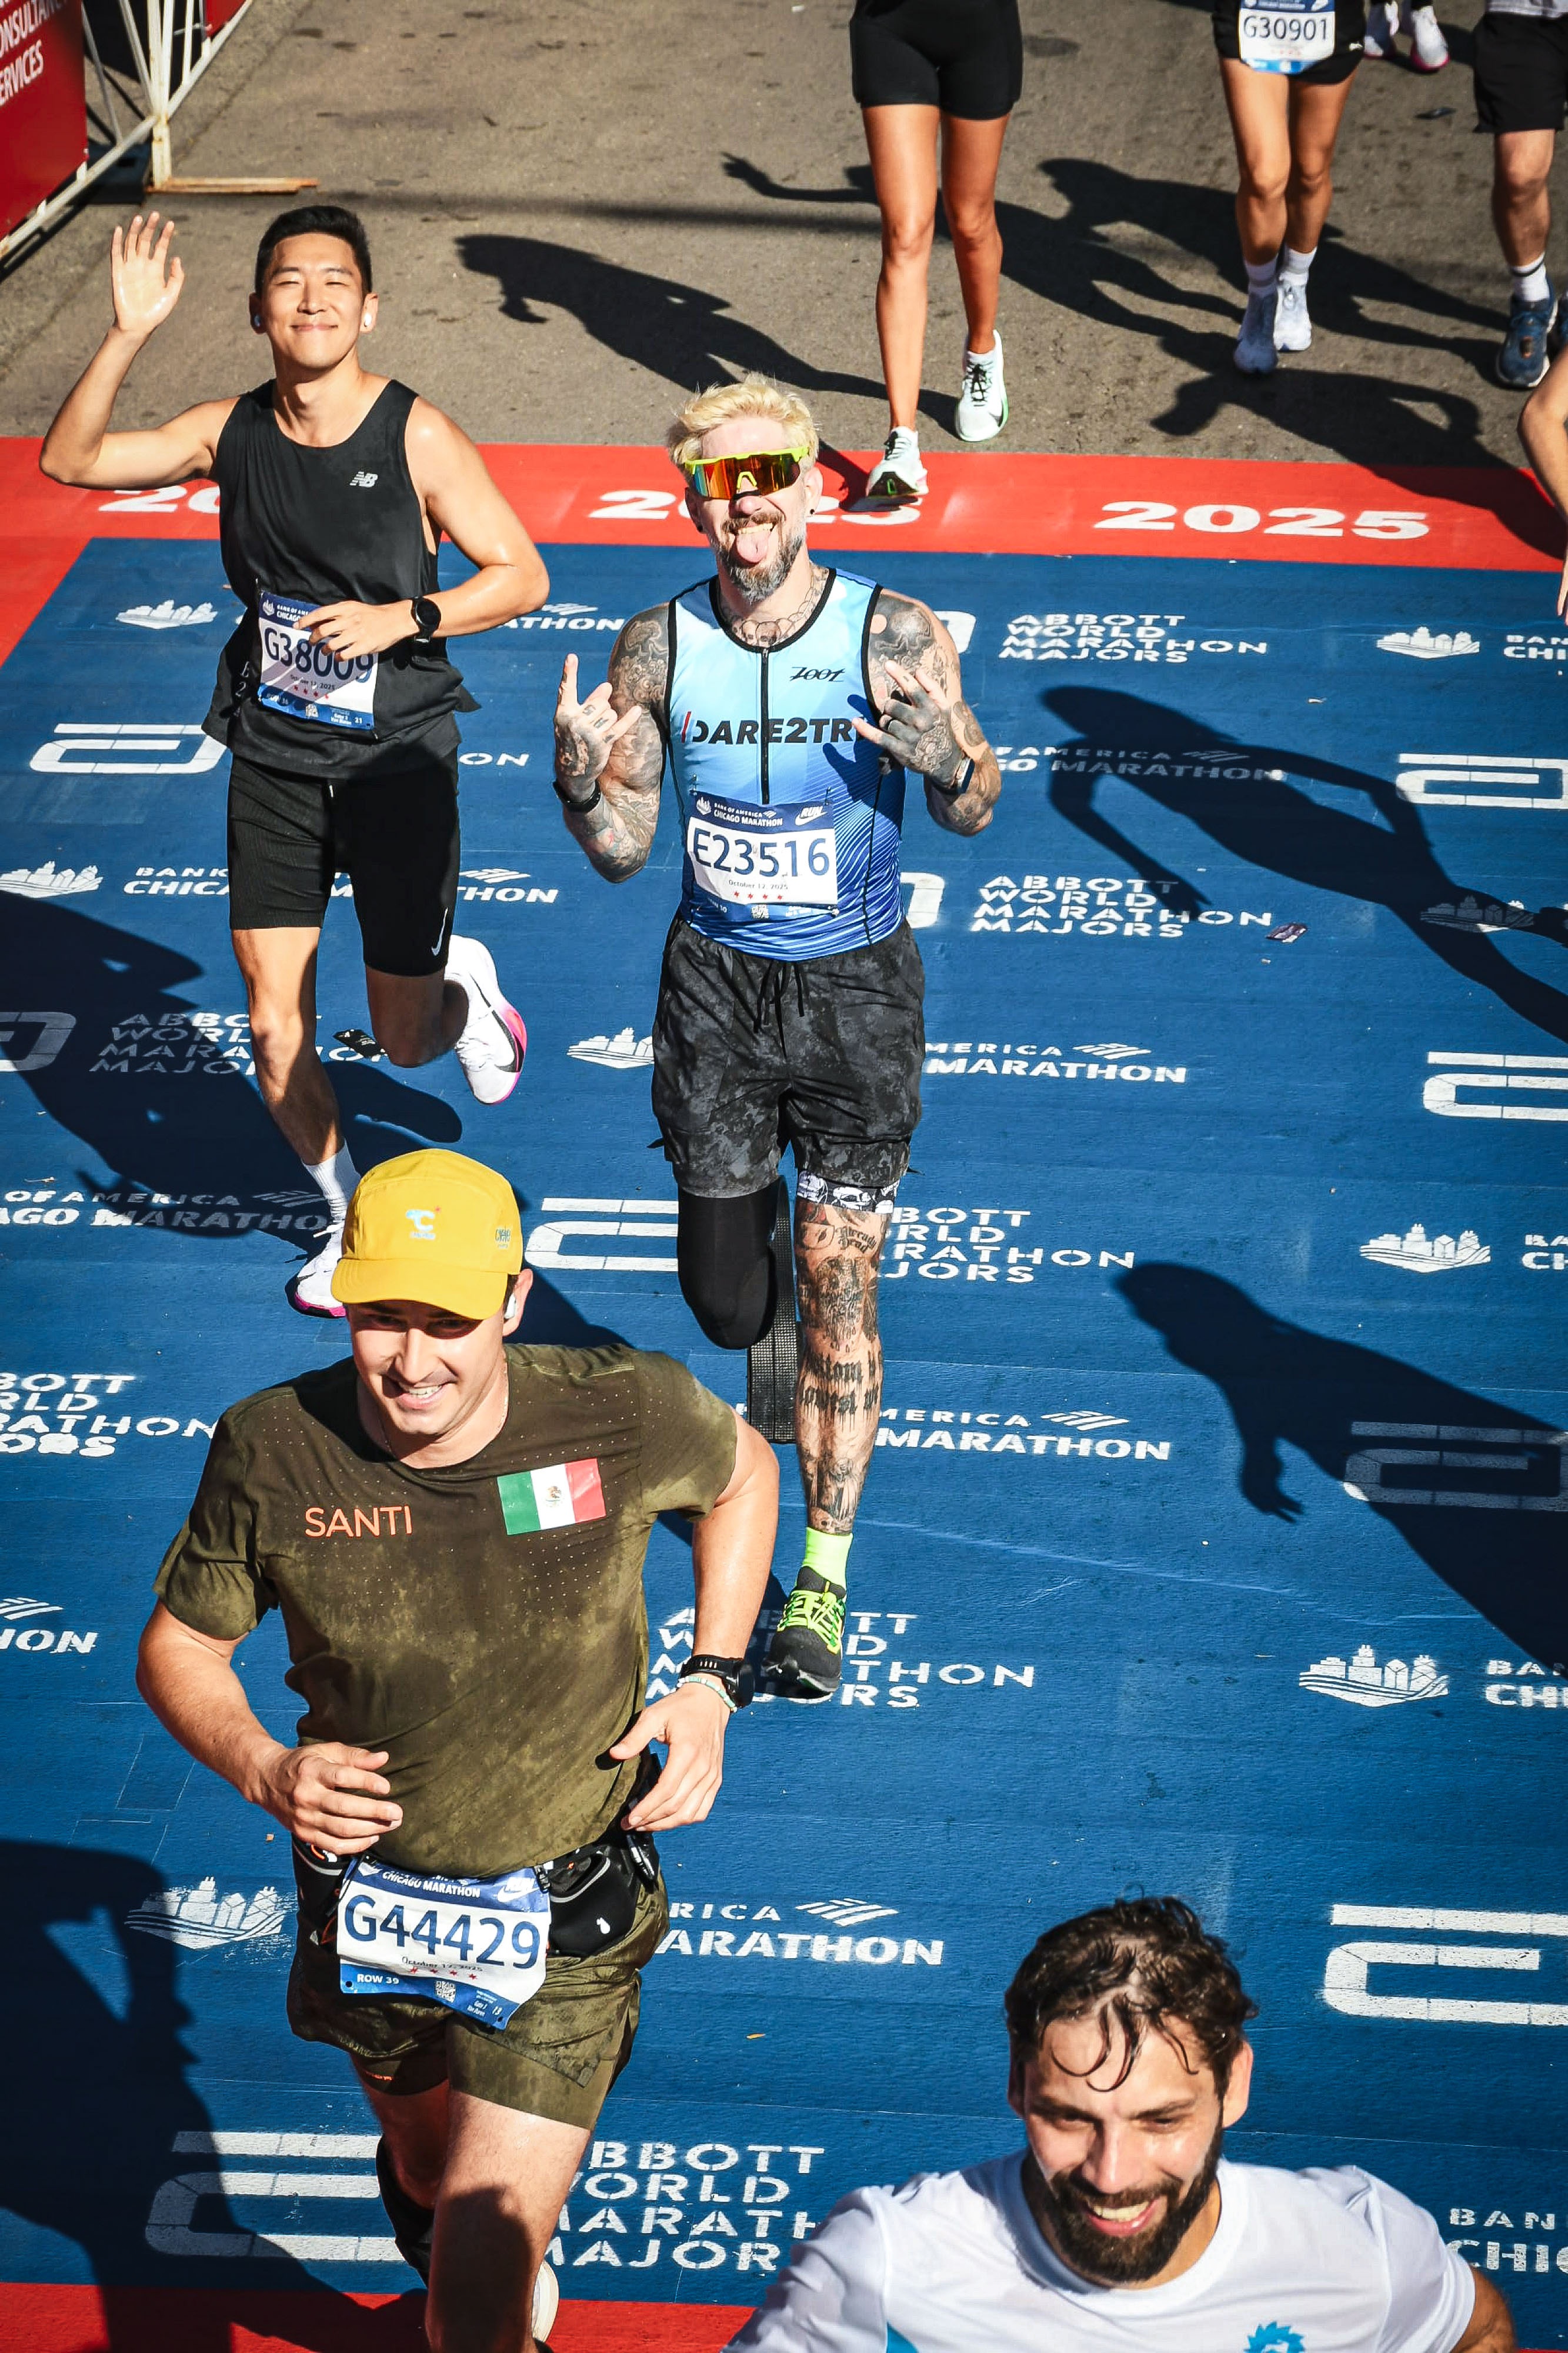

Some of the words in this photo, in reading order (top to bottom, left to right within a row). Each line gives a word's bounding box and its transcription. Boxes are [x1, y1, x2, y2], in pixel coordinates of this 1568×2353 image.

[1244, 15, 1327, 41] G30901
[1094, 501, 1430, 539] 2025
[1008, 624, 1165, 638] WORLD
[1012, 614, 1185, 626] ABBOTT
[265, 627, 373, 683] G38009
[1000, 646, 1188, 663] MAJORS
[1003, 635, 1267, 654] MARATHON
[1019, 746, 1172, 760] AMERICA
[1051, 759, 1287, 781] MARATHON
[713, 809, 740, 823] CHICAGO
[741, 816, 783, 827] MARATHON
[735, 809, 763, 818] AMERICA
[693, 827, 829, 877] E23516
[729, 879, 755, 889] October
[985, 875, 1178, 893] ABBOTT
[979, 888, 1157, 907] WORLD
[974, 904, 1272, 928] MARATHON
[971, 919, 1184, 938] MAJORS
[925, 1042, 1063, 1057] MERICA
[926, 1058, 1187, 1083] MARATHON
[61, 1191, 241, 1206] AMERICA
[90, 1208, 327, 1231] MARATHO
[875, 1427, 1170, 1461] MARATHON
[305, 1505, 413, 1538] SANTI
[382, 1871, 422, 1889] CHICAGO
[422, 1878, 481, 1898] MARATHON
[345, 1895, 541, 1969] G44429
[654, 1929, 944, 1966] ARATHON
[357, 1974, 383, 1984] ROW
[386, 1977, 399, 1985] 39
[589, 2141, 825, 2174] BBOTT
[569, 2172, 790, 2204] ORLD
[1450, 2208, 1568, 2230] BAN
